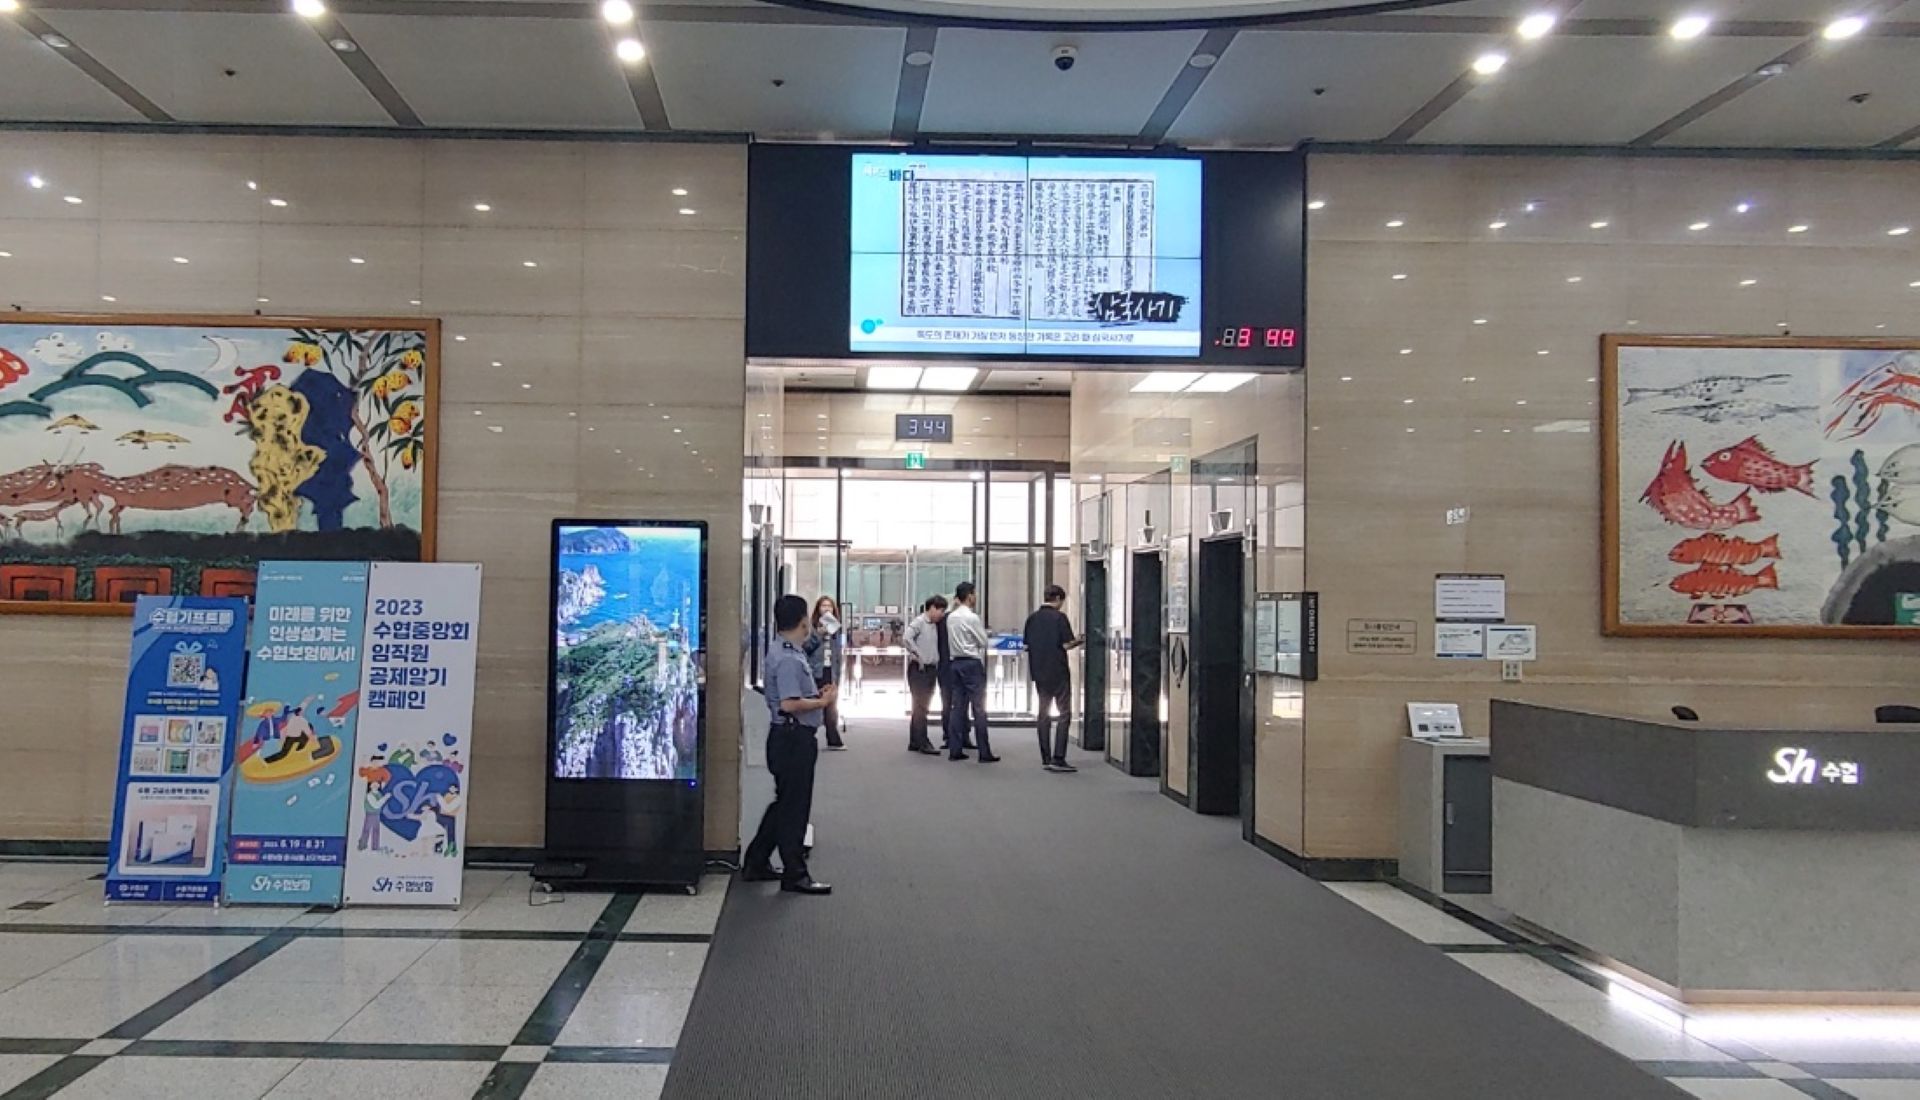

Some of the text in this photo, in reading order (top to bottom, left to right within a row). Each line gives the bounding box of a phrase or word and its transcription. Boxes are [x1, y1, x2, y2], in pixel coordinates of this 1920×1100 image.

[269, 605, 351, 622] 미래를 위한
[375, 599, 423, 615] 2023
[269, 625, 346, 642] 인생설계는
[373, 621, 470, 640] 수협중앙회
[256, 645, 355, 662] 수협보험에서!
[372, 643, 429, 662] 임직원
[369, 666, 447, 686] 공제알기
[368, 689, 426, 709] 캠페인
[1766, 748, 1859, 784] Sh 수협
[251, 875, 311, 891] Sh 수협보험
[372, 876, 433, 892] Sh 수협보험
